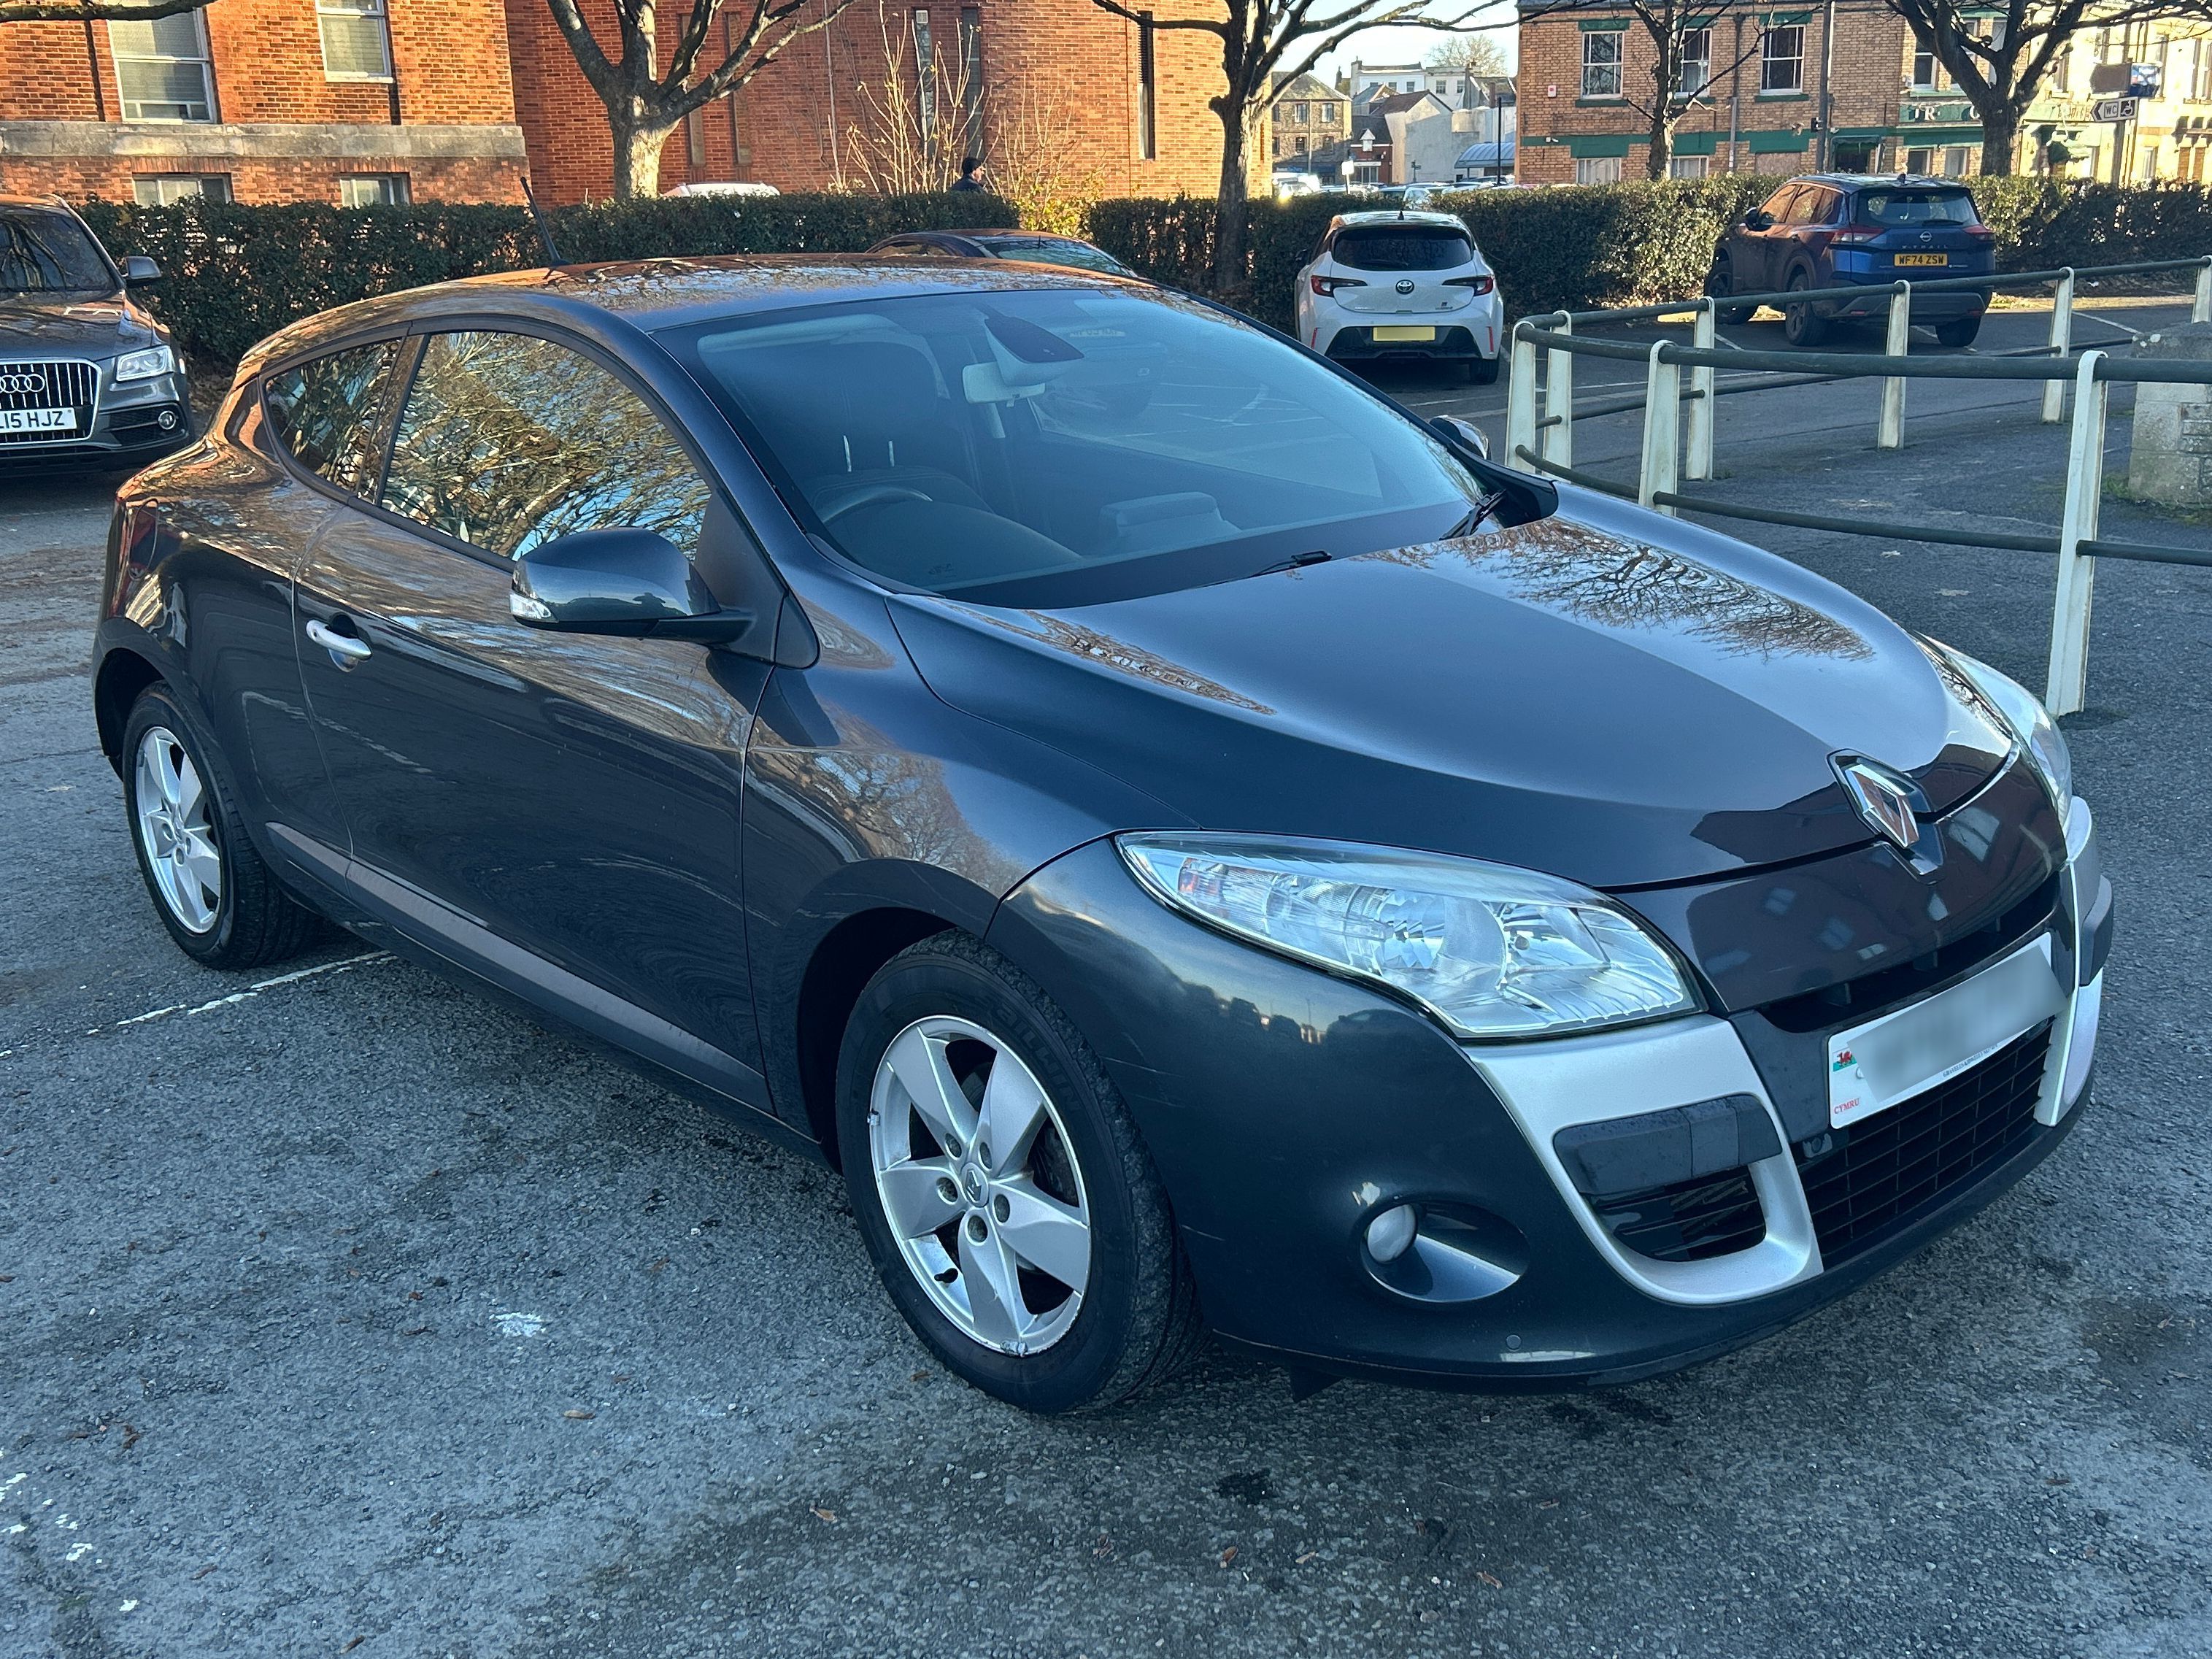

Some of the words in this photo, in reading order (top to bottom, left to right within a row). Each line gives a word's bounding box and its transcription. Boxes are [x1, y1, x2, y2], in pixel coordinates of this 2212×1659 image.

[2105, 105, 2117, 115] WC
[1899, 255, 1923, 264] WF74
[1926, 255, 1944, 264] ZSW
[0, 412, 22, 429] 15
[26, 410, 65, 428] HJZ
[1833, 1097, 1860, 1115] CYMRU
